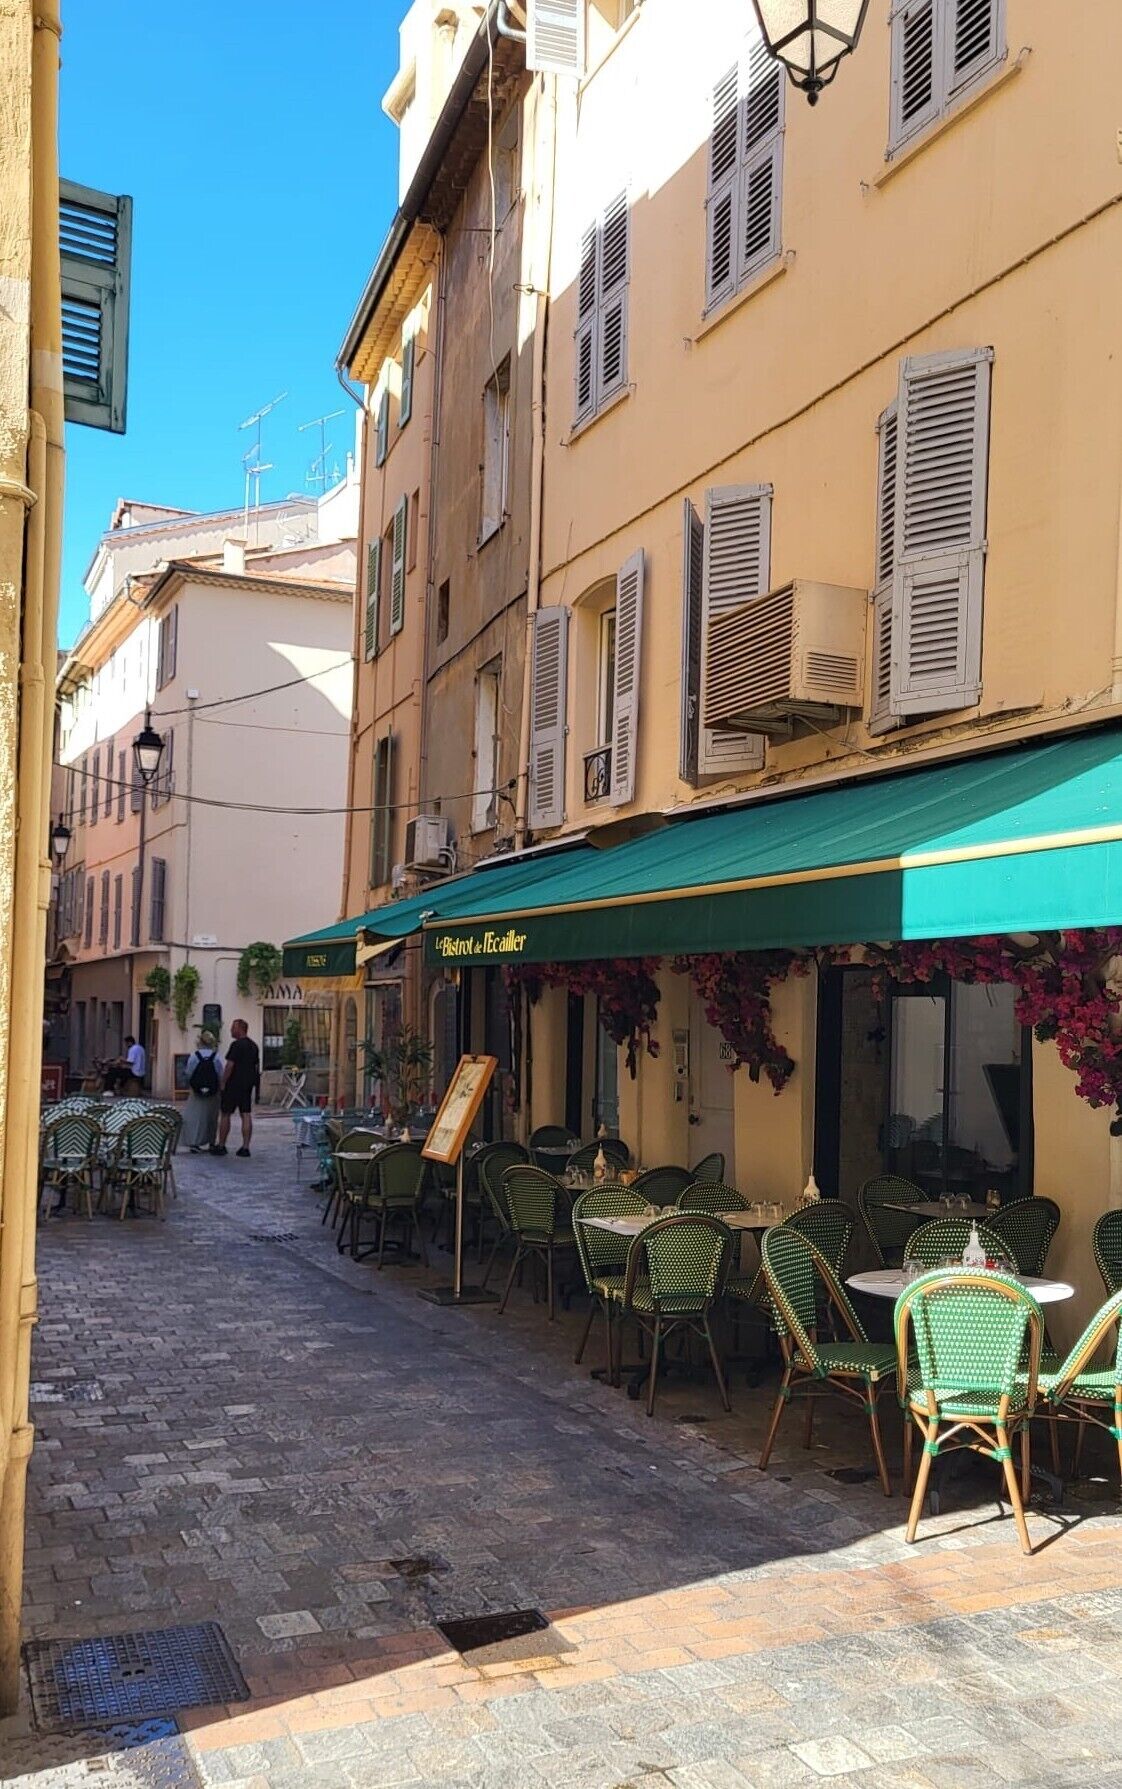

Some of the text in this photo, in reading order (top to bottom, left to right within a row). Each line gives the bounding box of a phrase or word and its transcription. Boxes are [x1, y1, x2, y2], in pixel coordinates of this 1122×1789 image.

[435, 936, 443, 950] Le
[442, 936, 474, 957] Bistrot
[473, 941, 482, 954] de
